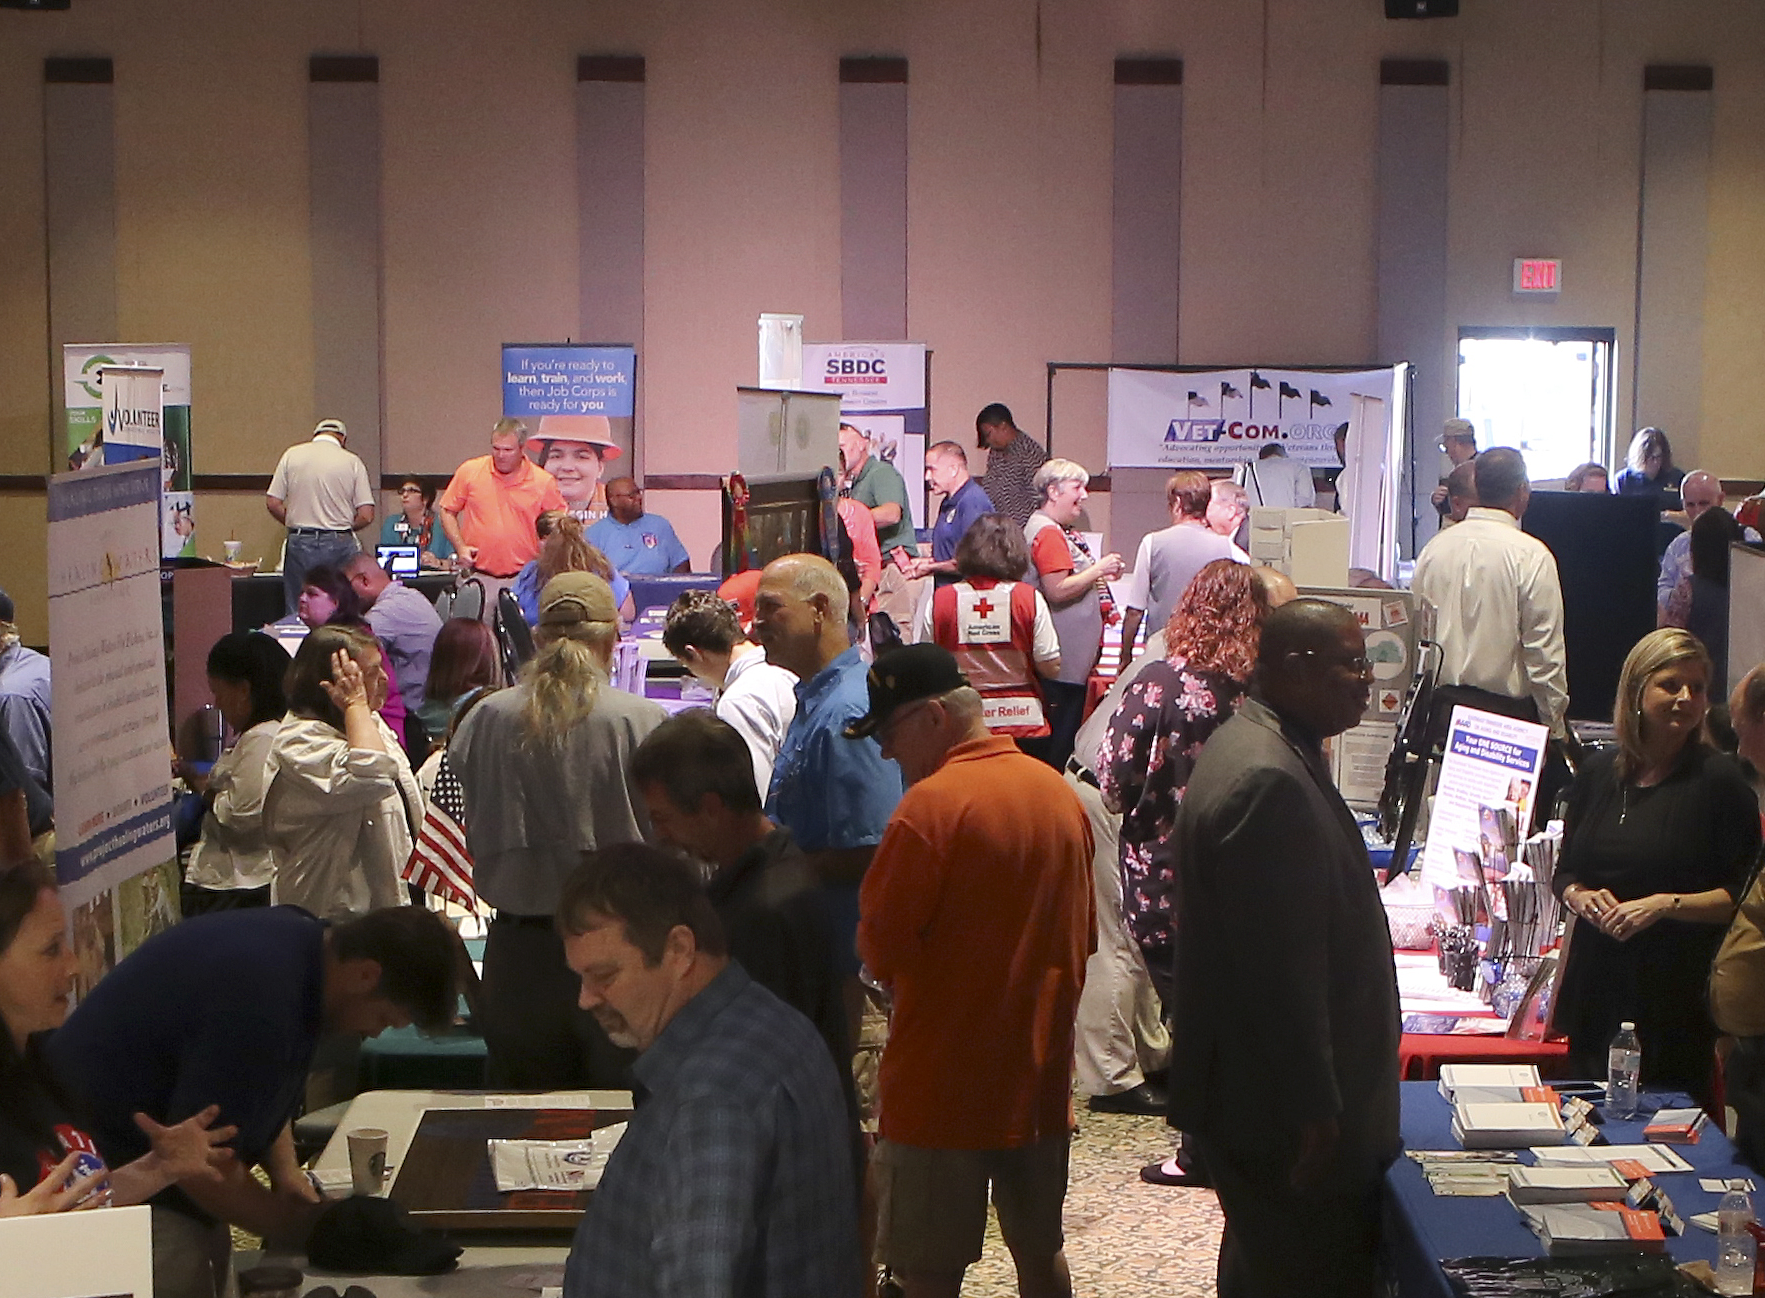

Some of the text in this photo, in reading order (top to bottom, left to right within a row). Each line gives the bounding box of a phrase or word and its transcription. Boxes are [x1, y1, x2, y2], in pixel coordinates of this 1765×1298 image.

[1521, 260, 1557, 289] EXIT
[521, 358, 615, 374] If you're ready to
[826, 359, 886, 375] SBDC
[507, 372, 628, 385] learn, train, and work,
[519, 385, 617, 399] then Job Corps is
[529, 398, 561, 413] ready
[563, 398, 578, 410] for
[117, 408, 161, 432] VOLUNTEER
[998, 705, 1031, 718] Relief
[1505, 754, 1531, 769] Services
